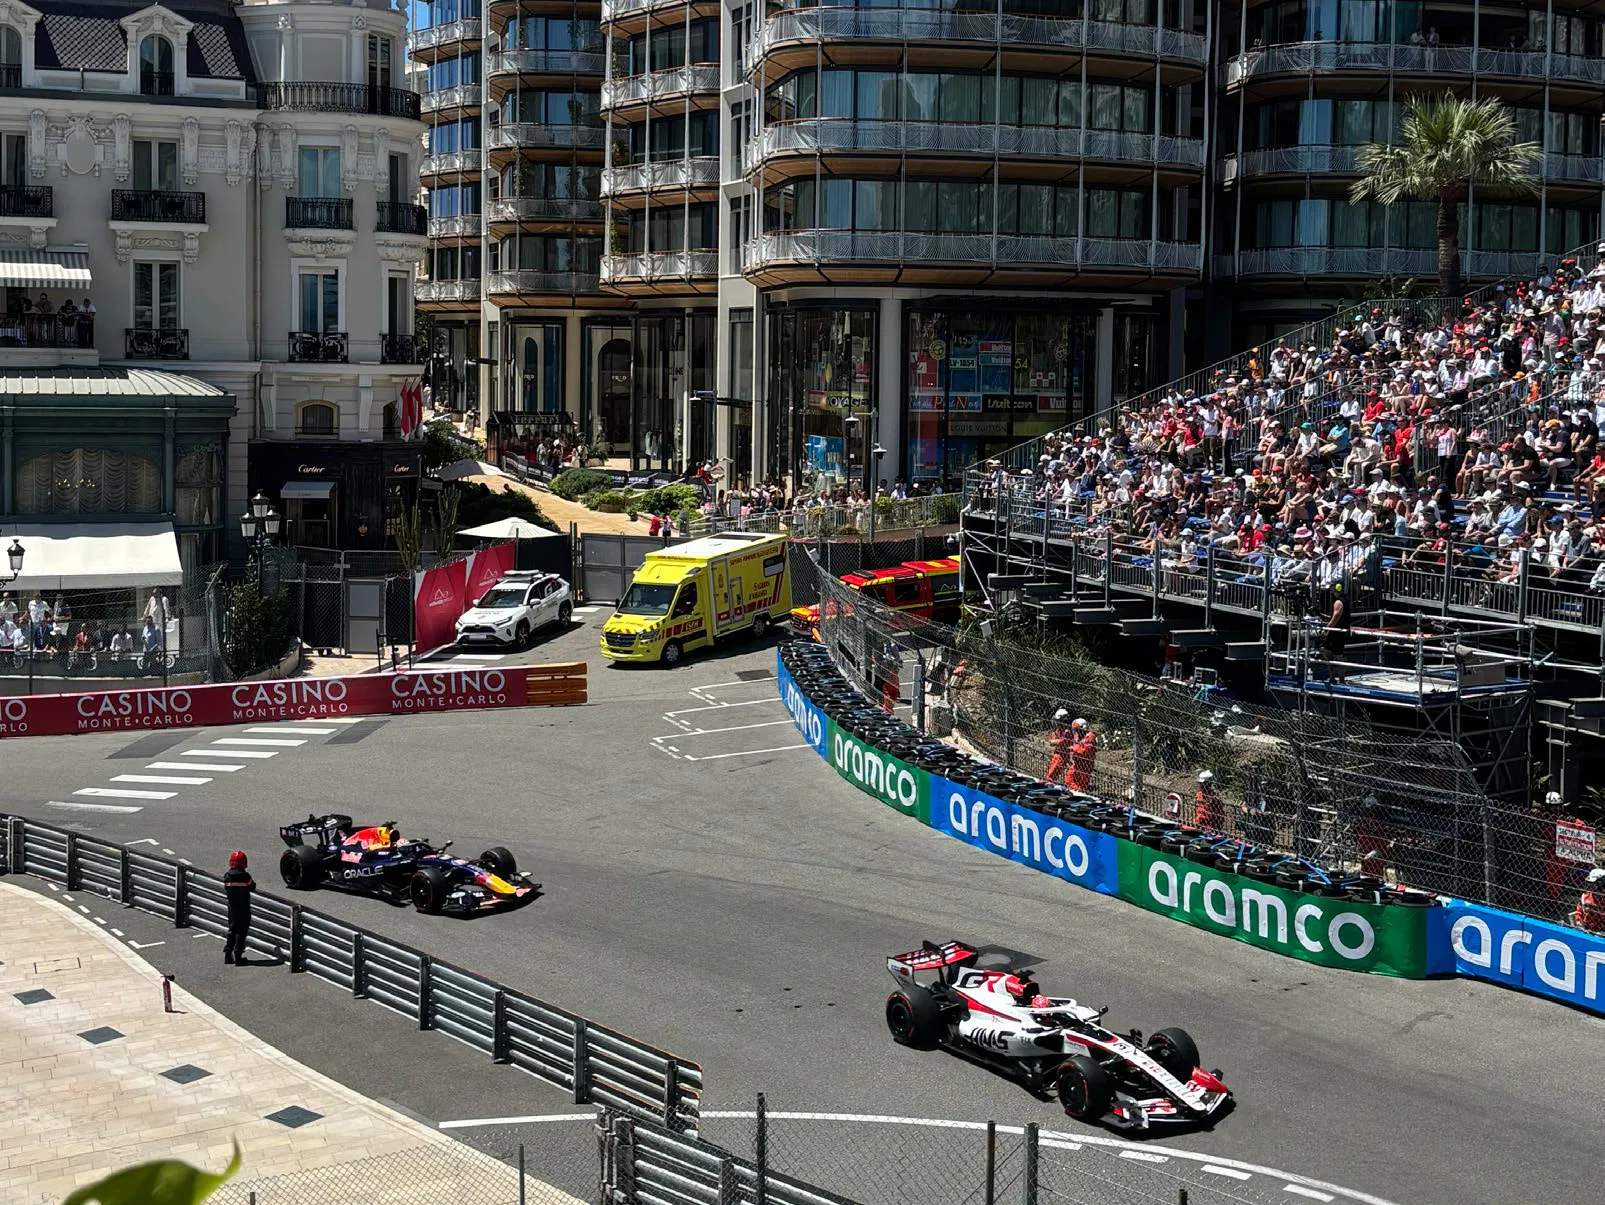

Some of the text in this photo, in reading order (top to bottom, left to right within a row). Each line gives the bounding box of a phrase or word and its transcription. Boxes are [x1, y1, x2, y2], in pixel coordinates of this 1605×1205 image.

[1049, 398, 1082, 409] Vuio
[298, 463, 326, 474] Cartier
[393, 464, 410, 473] Cartier
[232, 678, 347, 708] CASINO
[392, 669, 506, 698] CASINO
[77, 689, 192, 717] CASINO
[787, 682, 822, 746] aamco
[835, 732, 918, 807] aramco
[950, 792, 1089, 877] aramco
[343, 865, 384, 880] ORACLE
[1148, 860, 1376, 961] aramco
